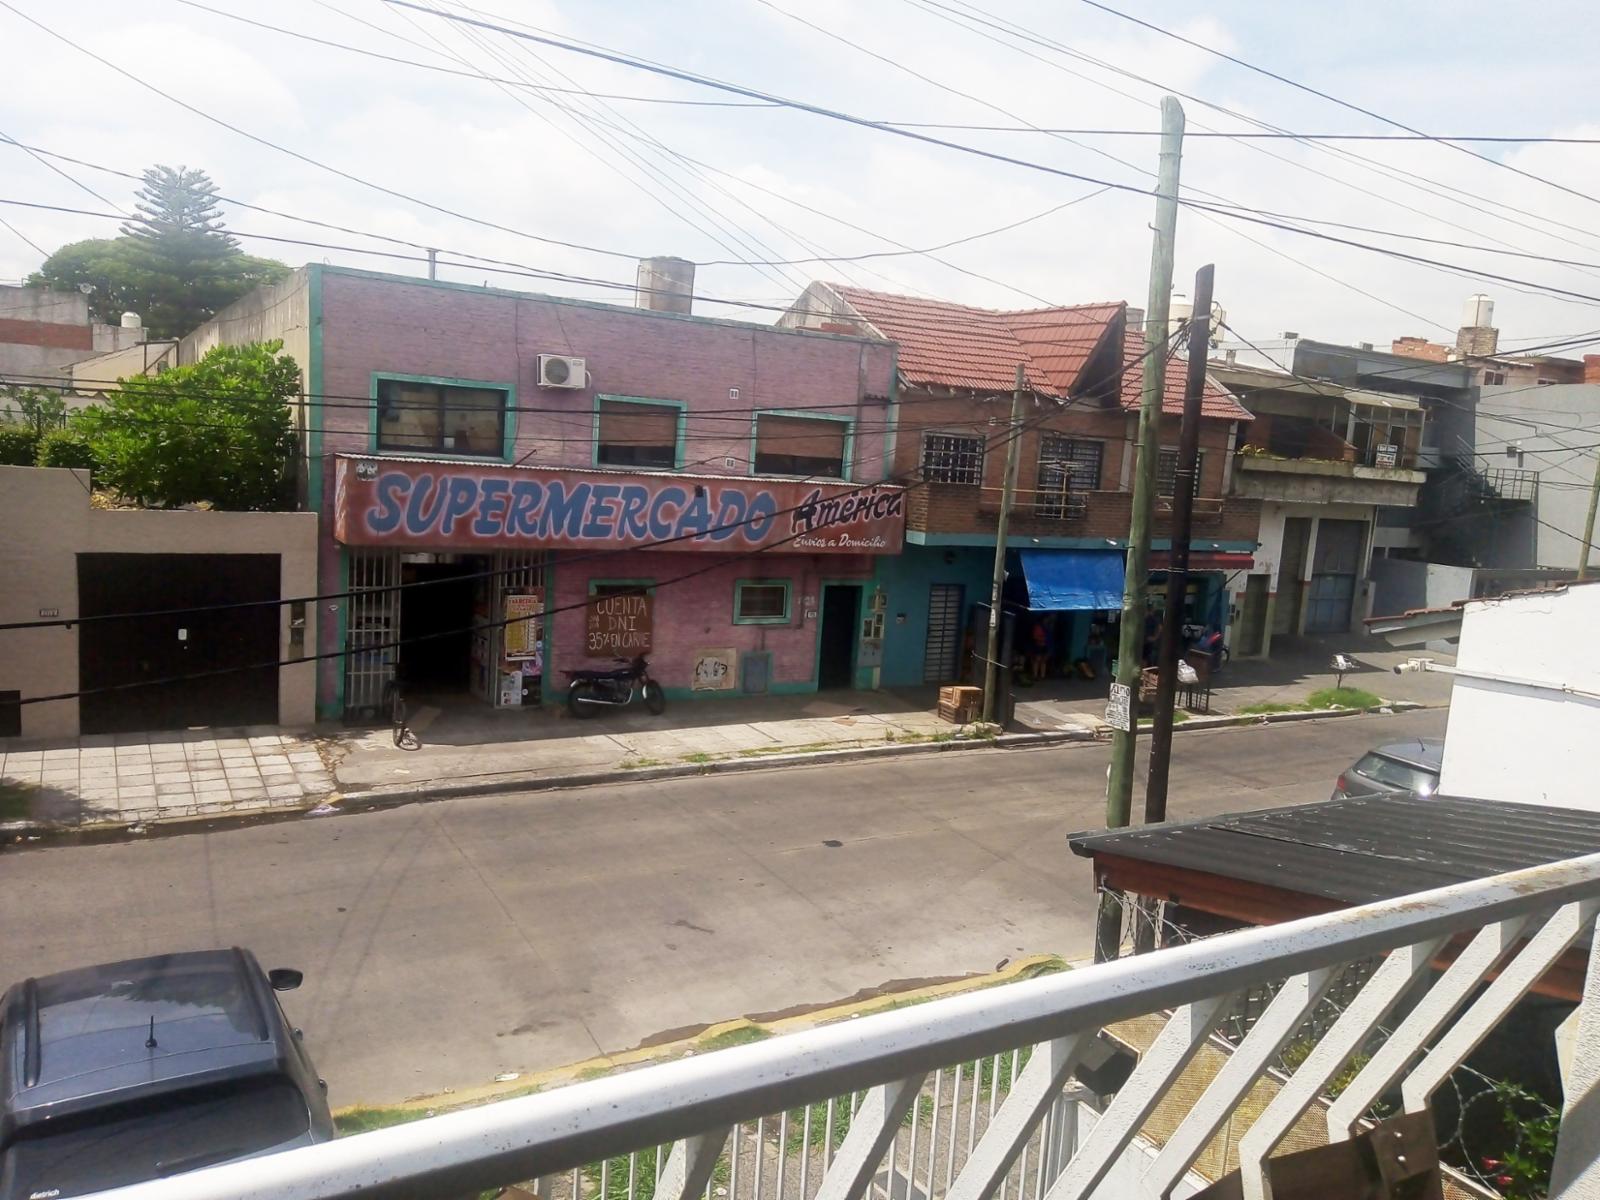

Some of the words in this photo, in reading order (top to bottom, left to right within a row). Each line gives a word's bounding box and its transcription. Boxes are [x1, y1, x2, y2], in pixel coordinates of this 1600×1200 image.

[366, 473, 776, 543] SUPERMERCADO
[838, 533, 886, 548] Domicilio
[597, 597, 647, 616] CUENTA
[608, 615, 637, 631] DNI
